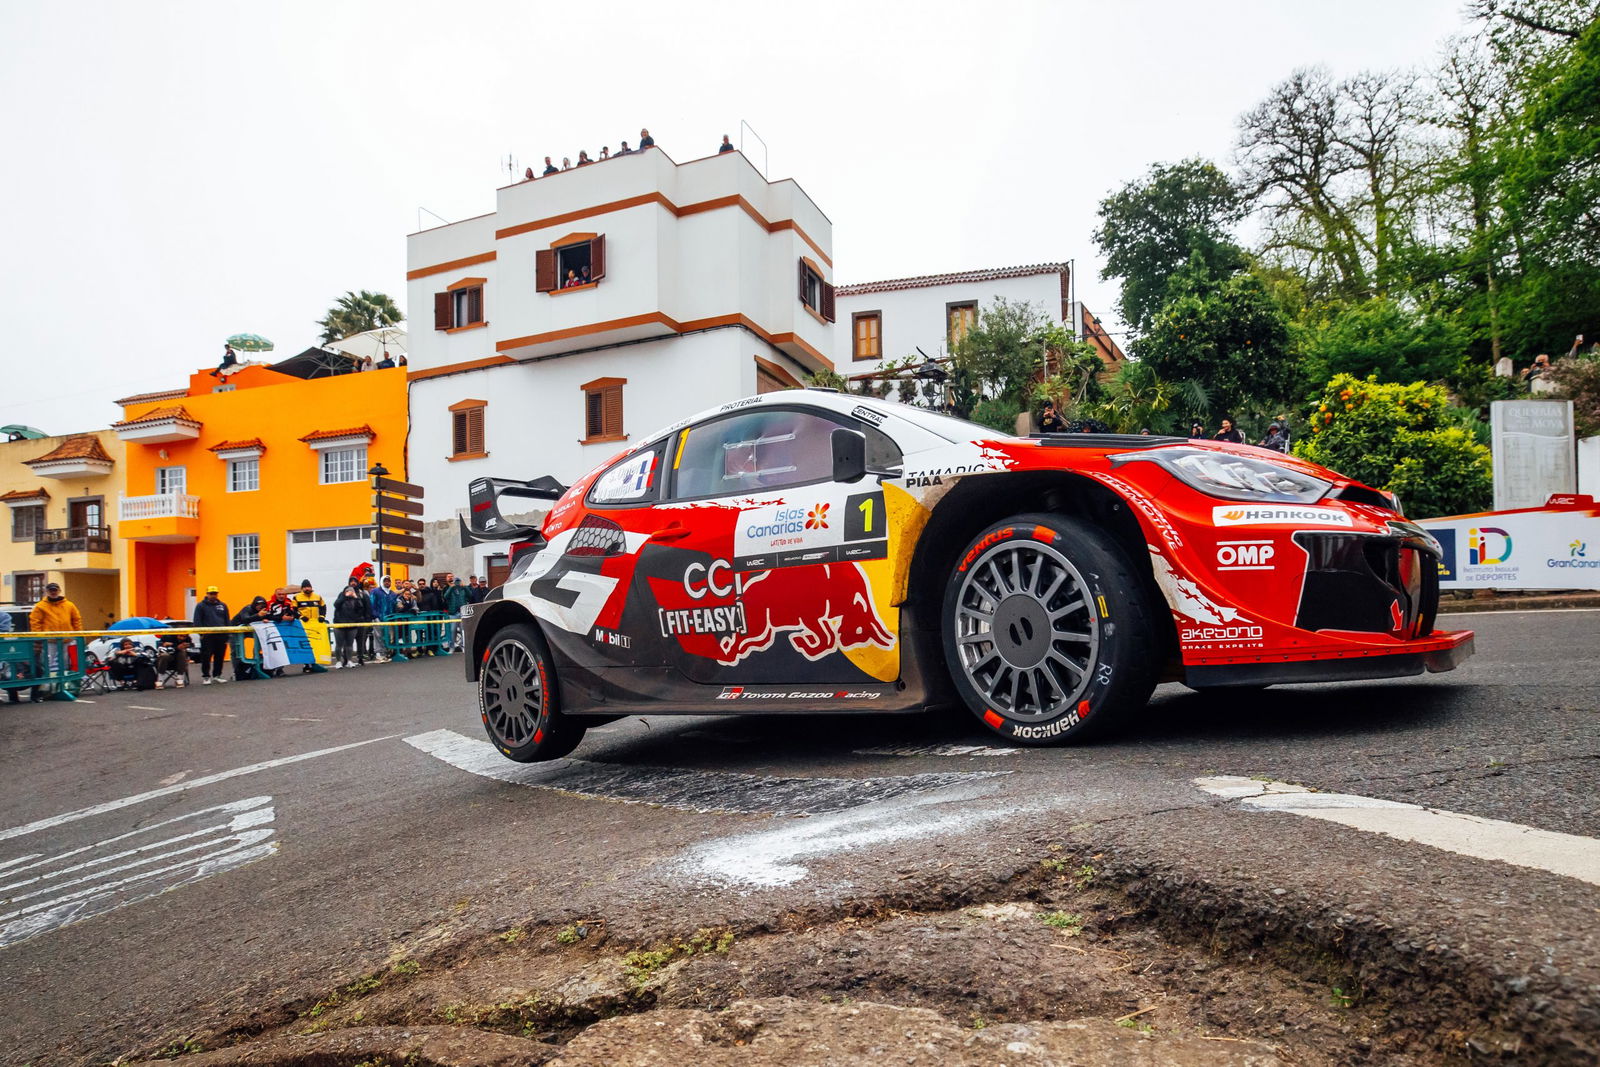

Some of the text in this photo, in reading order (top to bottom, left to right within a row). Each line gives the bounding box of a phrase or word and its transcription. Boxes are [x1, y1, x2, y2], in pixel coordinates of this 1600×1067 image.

[720, 396, 763, 412] PROTERIAL
[853, 406, 883, 424] CENTRAL
[906, 476, 943, 488] PIAA
[775, 508, 804, 522] Islas
[859, 498, 873, 532] 1
[747, 521, 804, 538] Canarias
[1217, 546, 1274, 564] OMP
[1475, 573, 1517, 581] DEPORTES
[596, 629, 620, 646] Mobil
